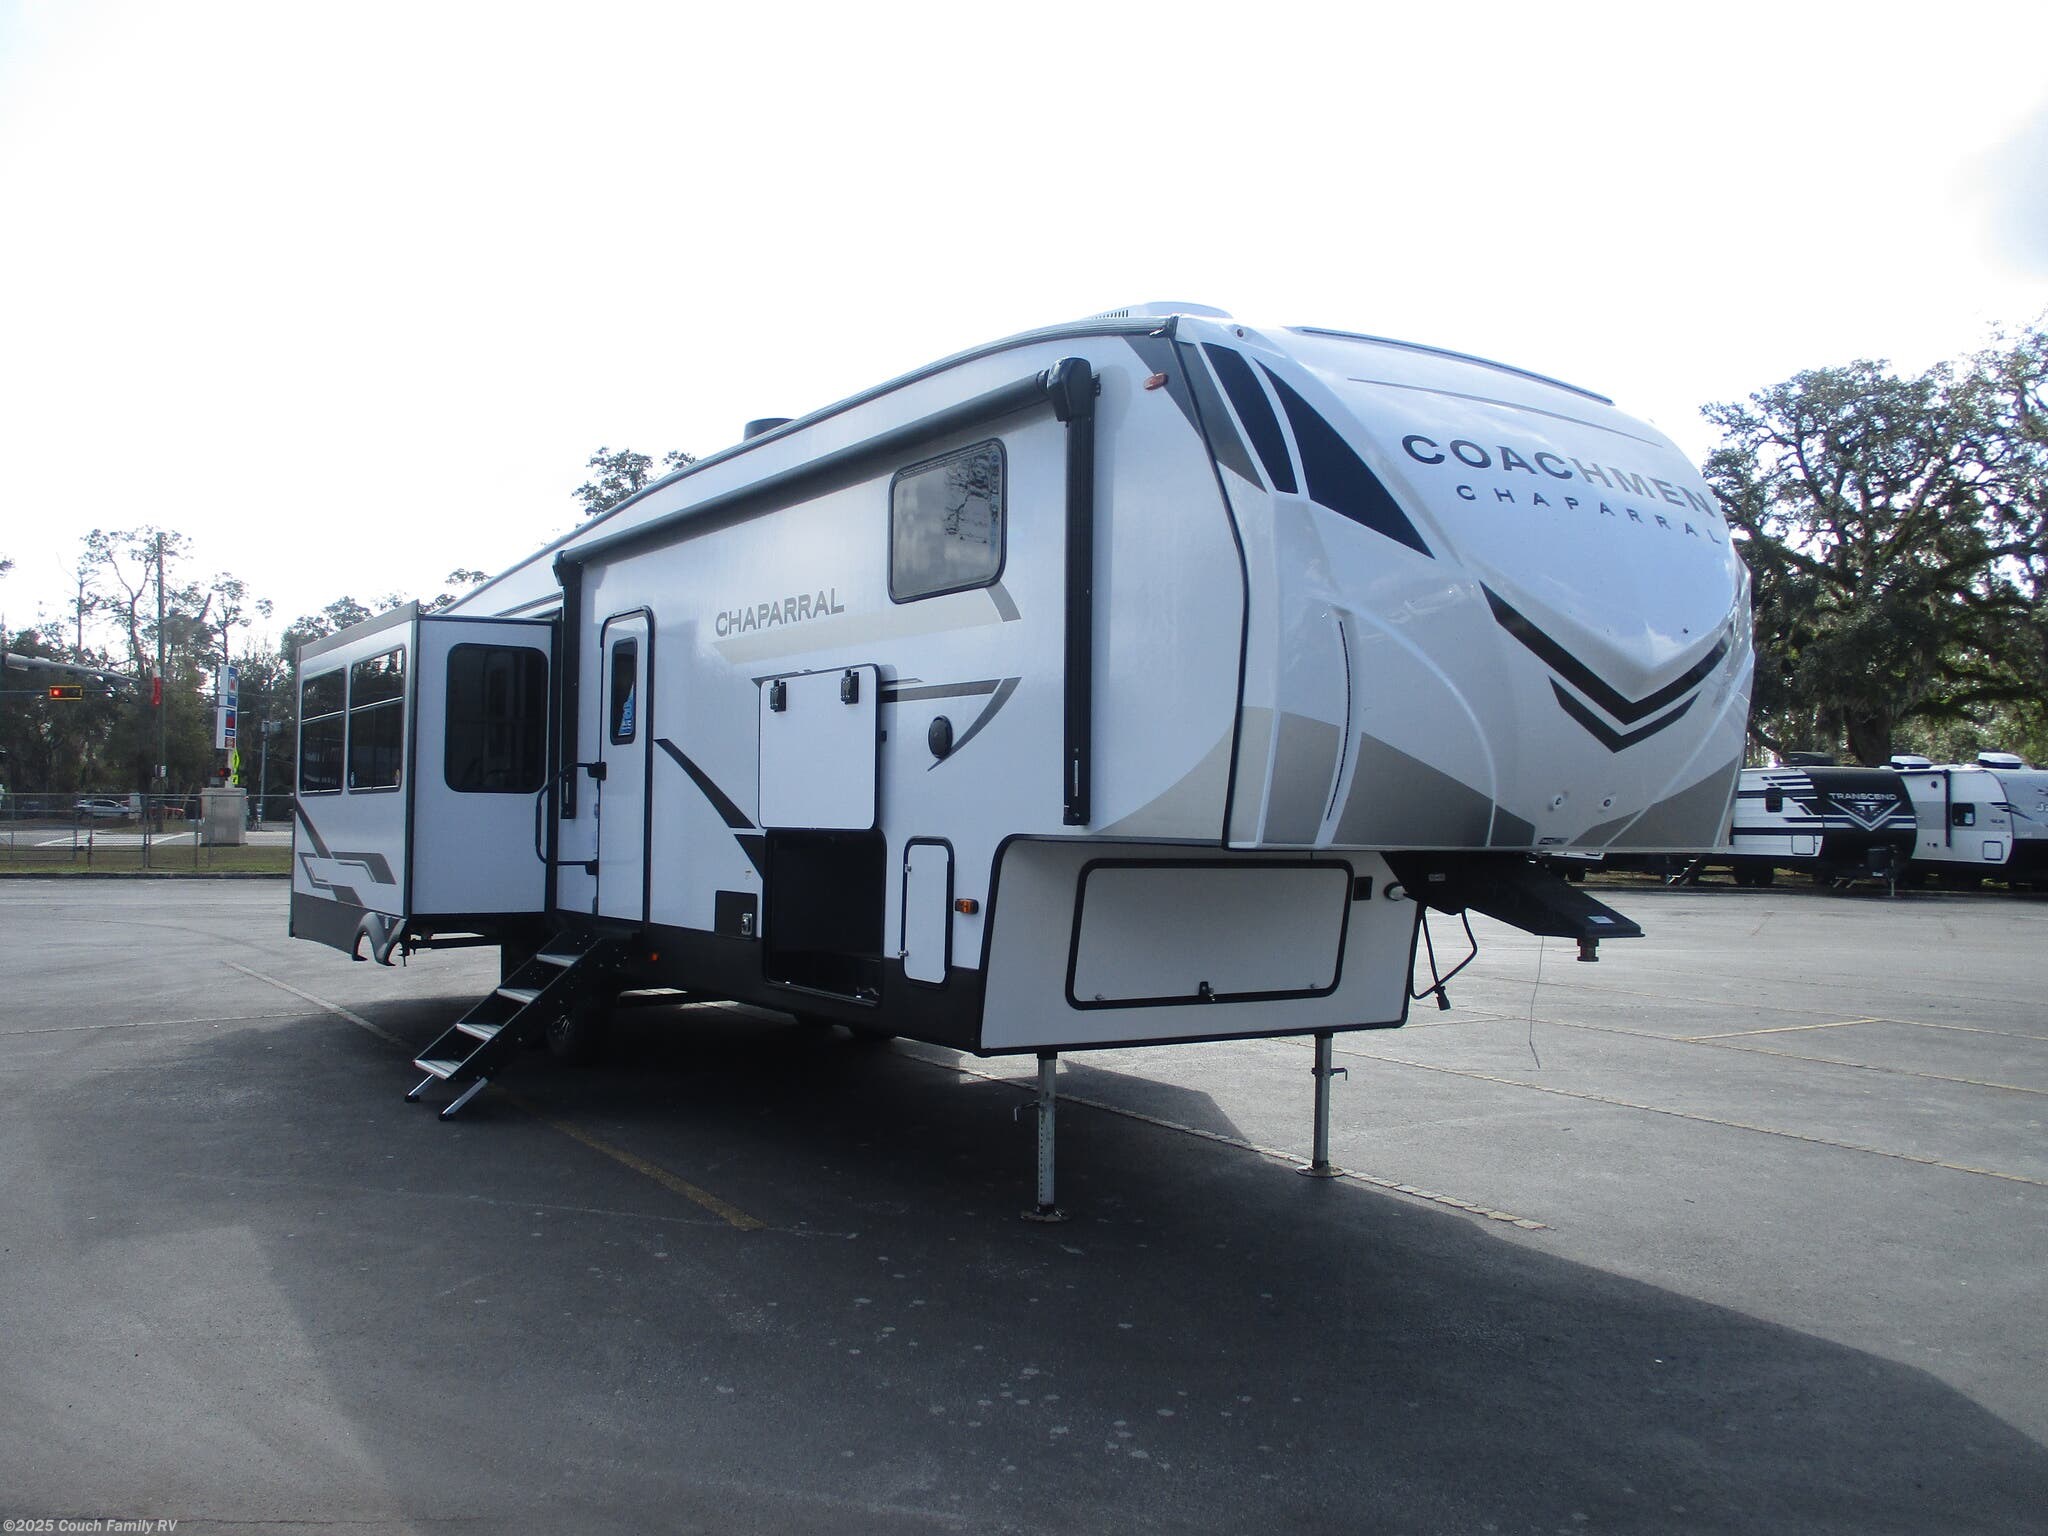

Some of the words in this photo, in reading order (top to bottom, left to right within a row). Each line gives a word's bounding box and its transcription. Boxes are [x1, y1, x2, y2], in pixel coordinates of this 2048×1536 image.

[1402, 434, 1716, 518] COACHMEN
[1456, 484, 1722, 545] CHAPARRAL
[715, 587, 845, 637] CHAPARRAL
[1828, 792, 1898, 801] TRANSCEND
